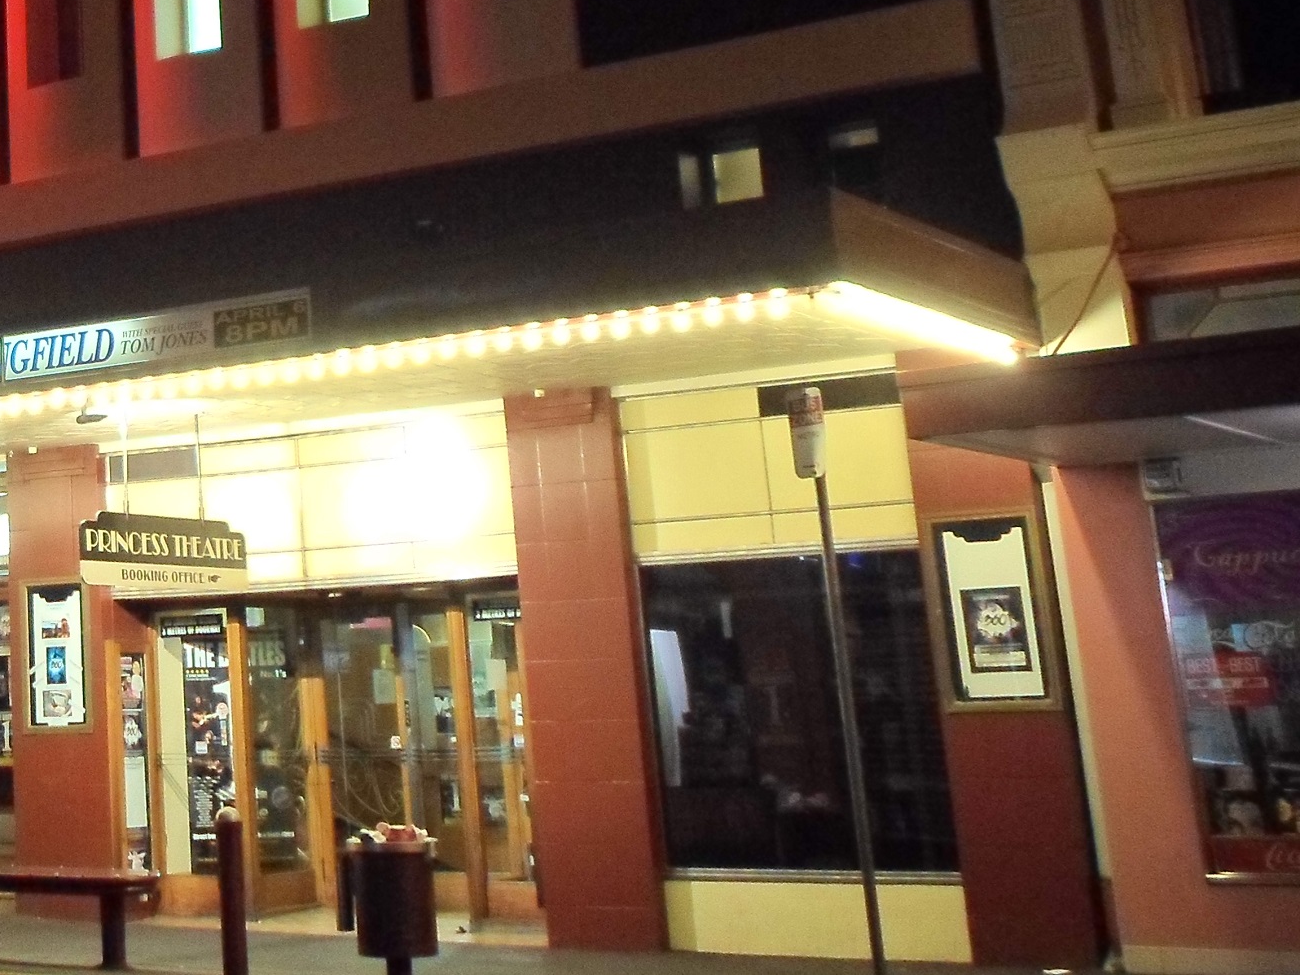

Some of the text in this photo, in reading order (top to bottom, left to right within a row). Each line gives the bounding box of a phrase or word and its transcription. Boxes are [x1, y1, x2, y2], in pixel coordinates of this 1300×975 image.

[216, 305, 285, 324] APRIL
[120, 330, 207, 356] TOM JONES
[122, 328, 142, 338] WITH
[225, 317, 299, 343] 8PM
[85, 528, 244, 561] PRINCESS THEATRE
[121, 568, 205, 584] BOOKING OFFICE
[183, 642, 216, 668] THE
